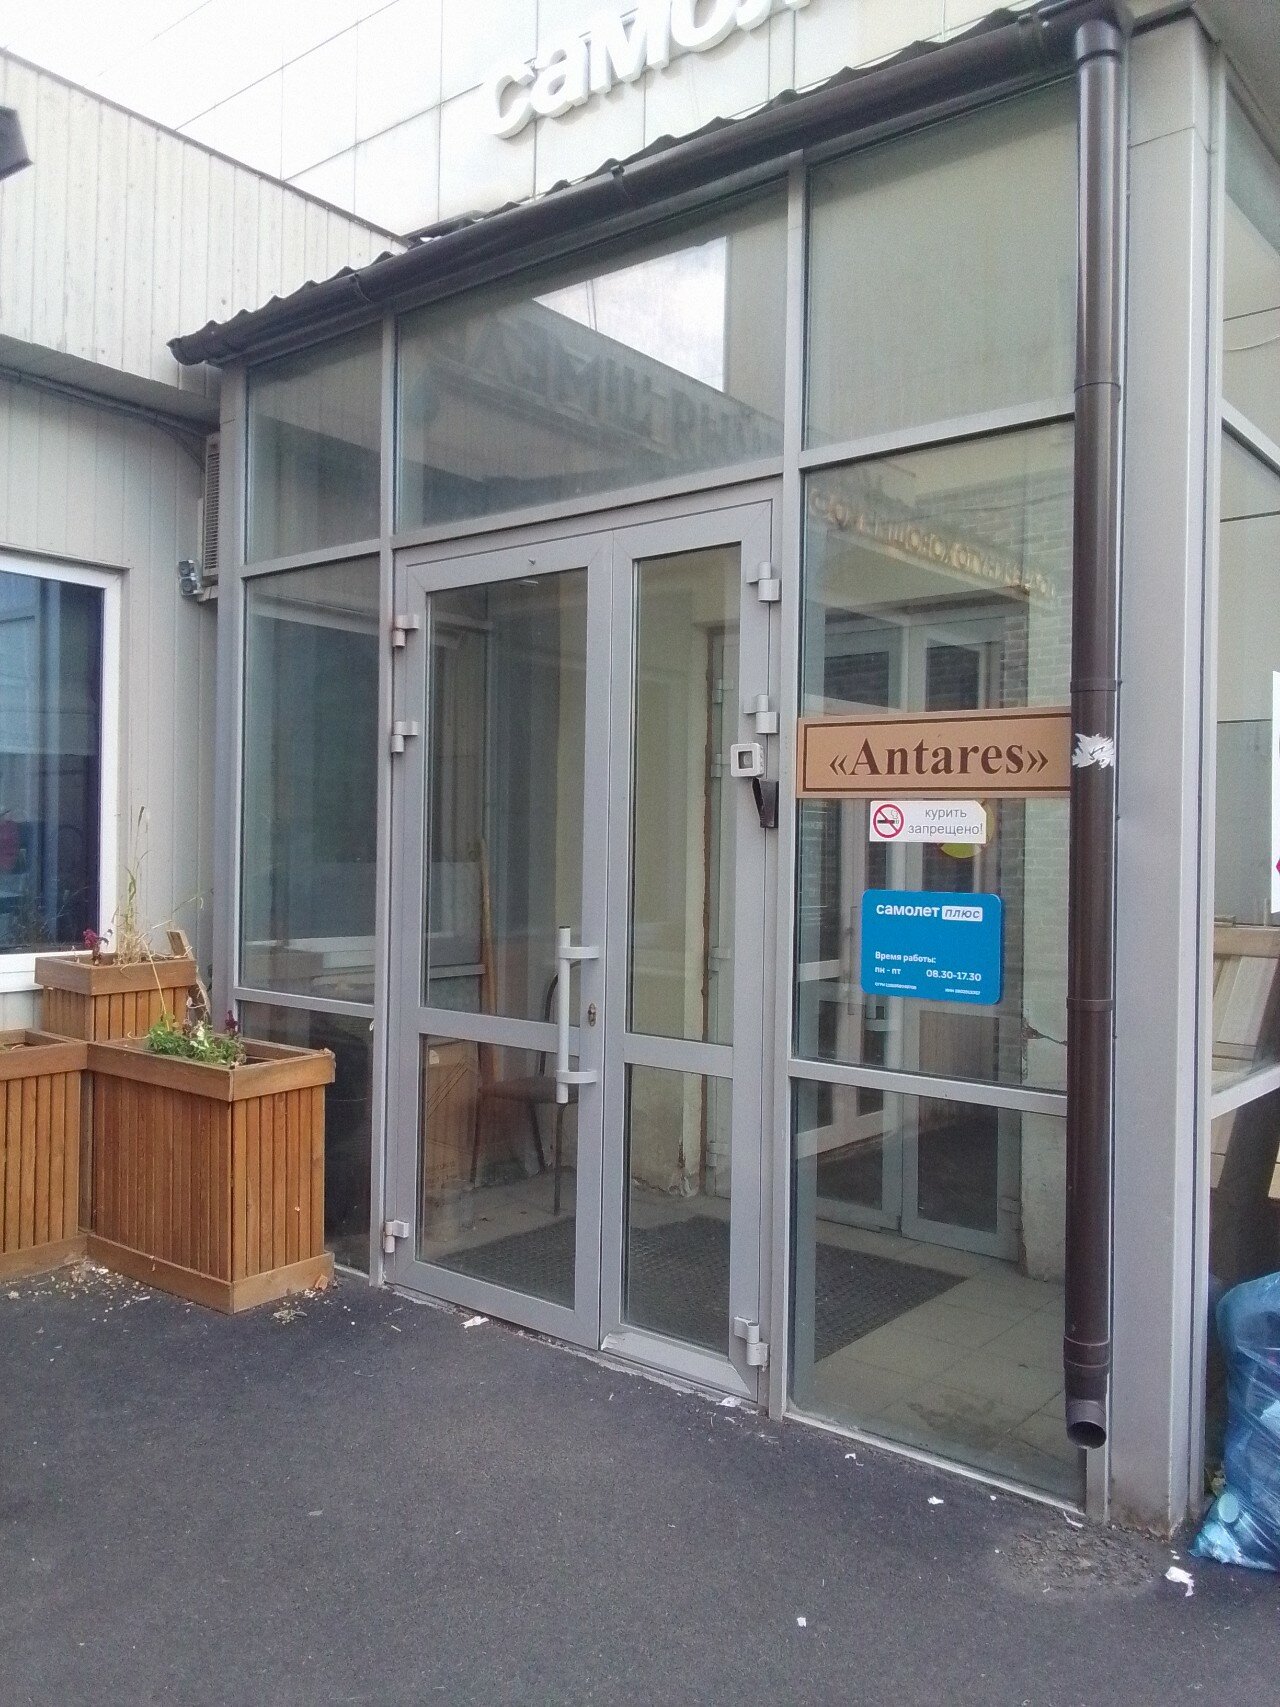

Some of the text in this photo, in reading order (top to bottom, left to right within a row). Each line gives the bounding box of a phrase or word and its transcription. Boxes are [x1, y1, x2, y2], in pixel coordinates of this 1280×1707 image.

[482, 0, 810, 139] само
[829, 737, 1049, 776] «Antares»
[924, 807, 967, 820] курить
[908, 823, 984, 836] запрещено!
[876, 904, 980, 919] самолет плюс
[875, 951, 936, 964] Время работы:
[891, 967, 901, 975] пт
[926, 969, 982, 982] 08.30-17.30
